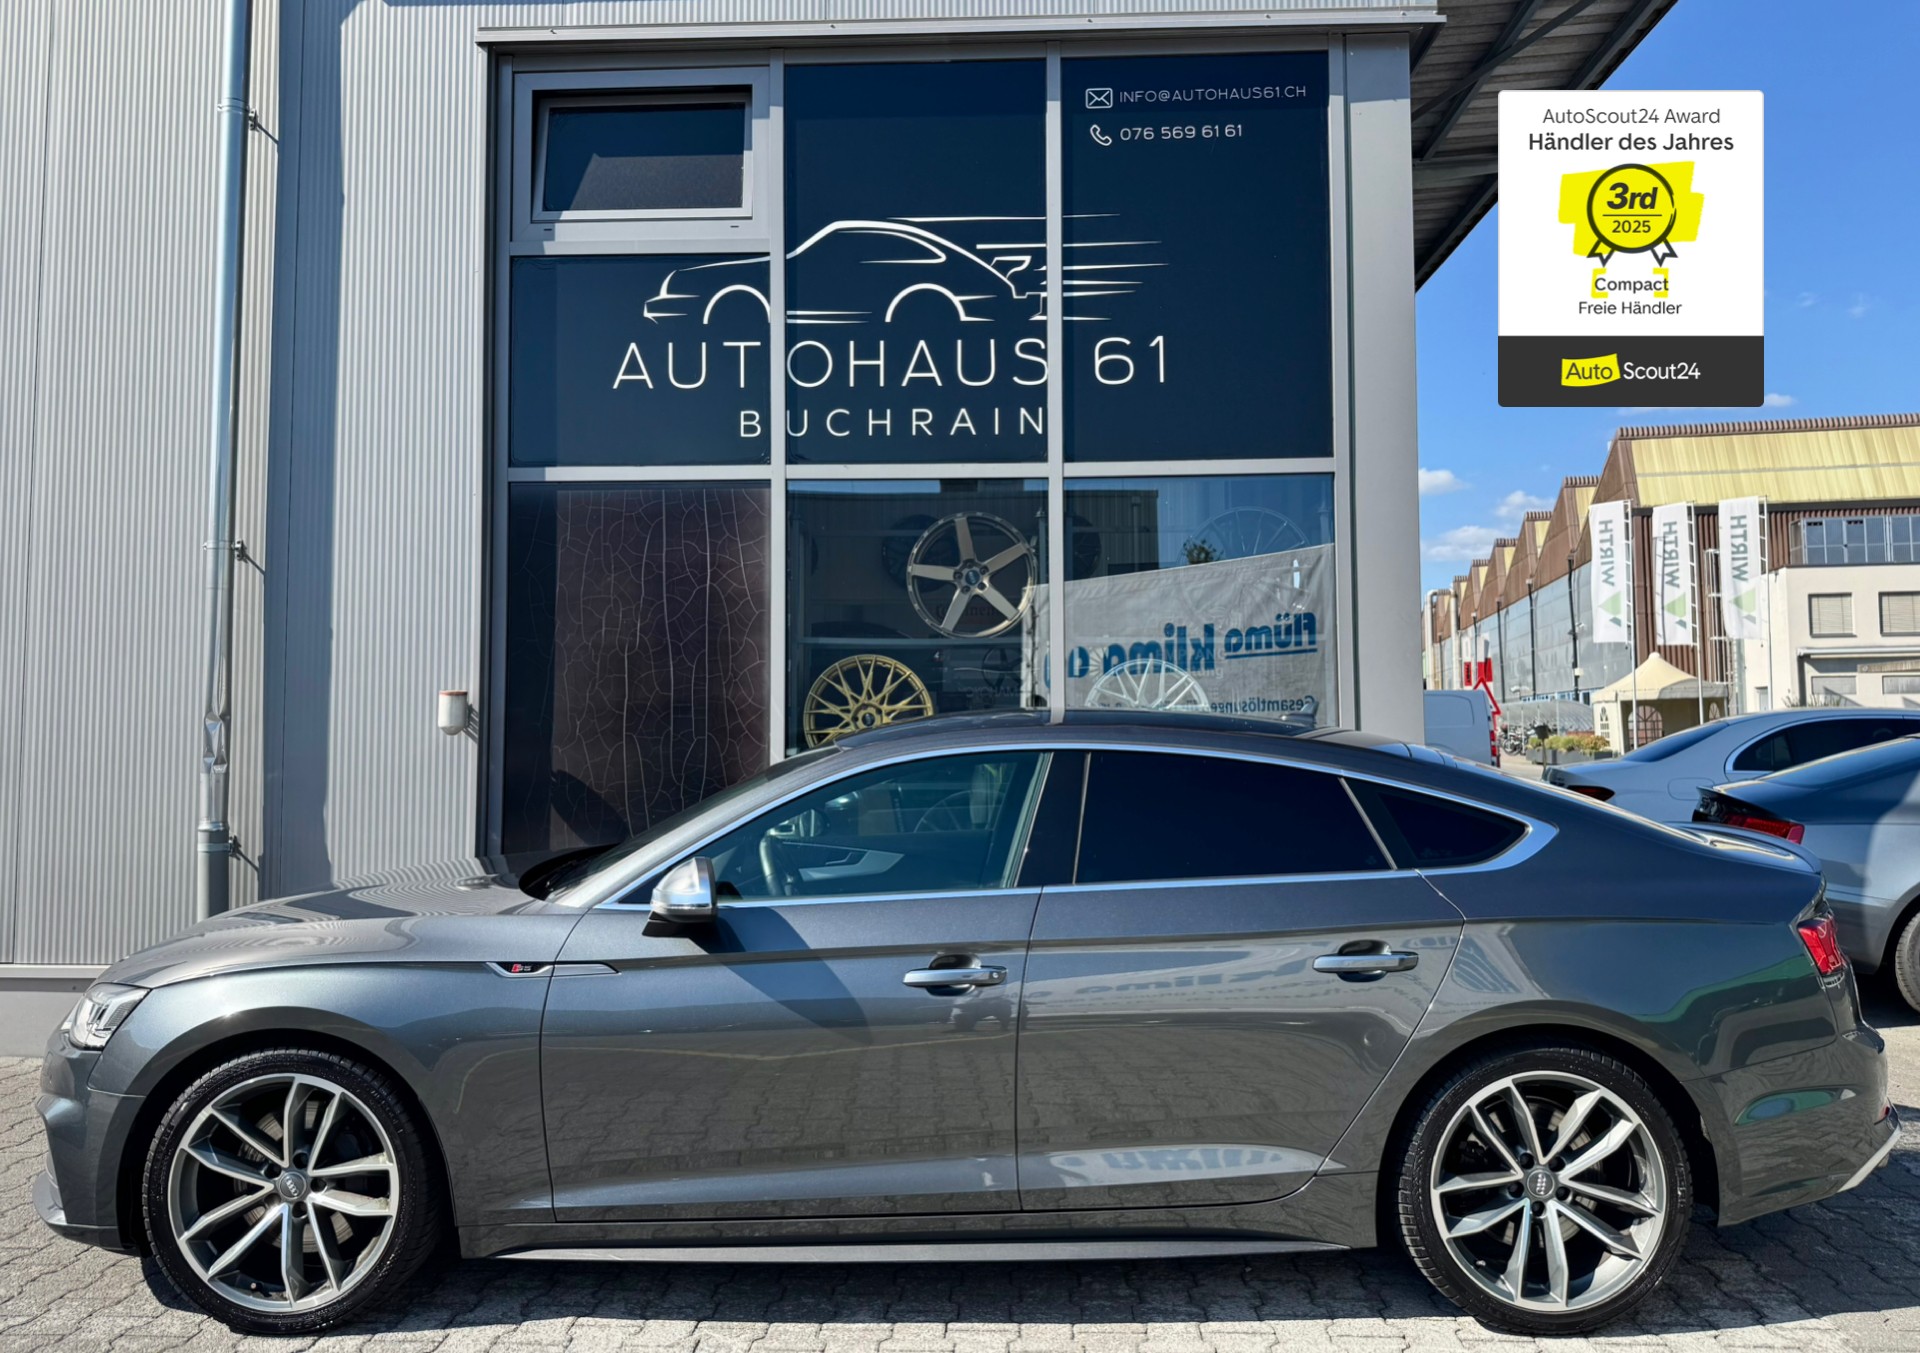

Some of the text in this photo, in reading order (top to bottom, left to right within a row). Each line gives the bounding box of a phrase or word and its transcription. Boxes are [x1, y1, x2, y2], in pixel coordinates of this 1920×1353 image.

[1119, 85, 1307, 103] INFO@AUTOHAUS61.CH
[1119, 123, 1243, 141] 076 569 61 61
[612, 335, 1166, 390] AUTOHAUS 61
[740, 407, 1044, 438] BUCHRAIN
